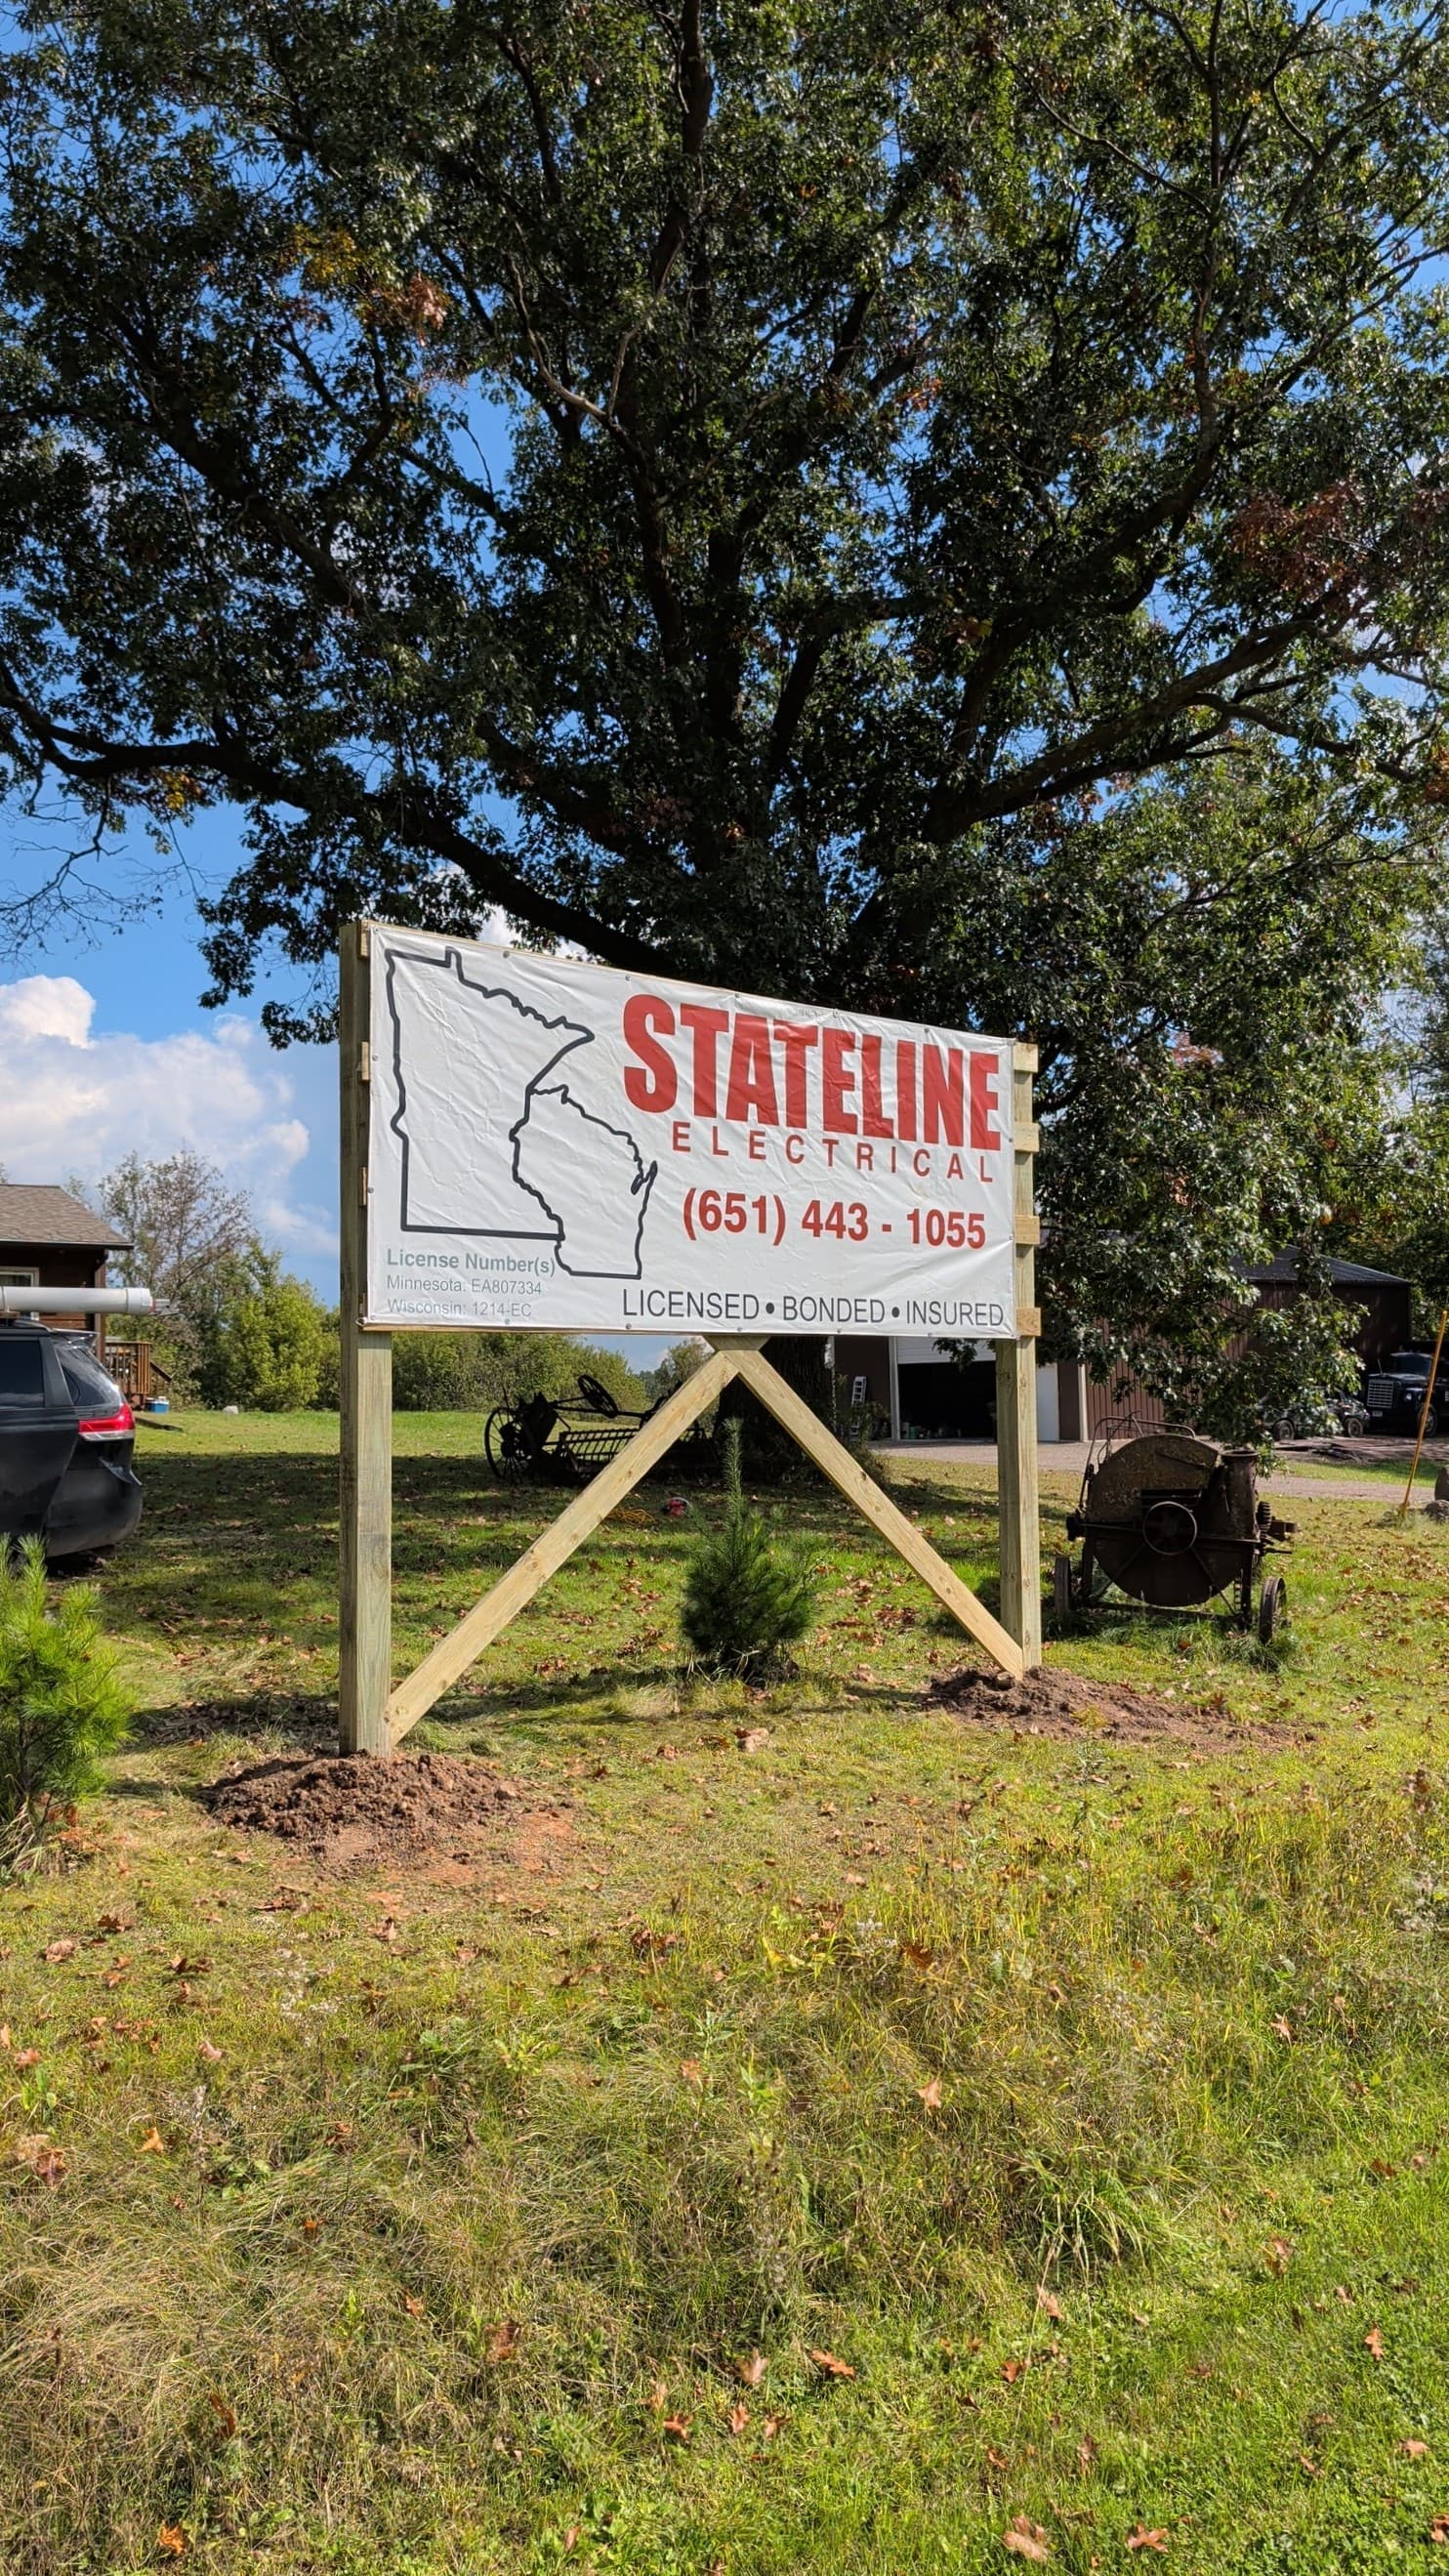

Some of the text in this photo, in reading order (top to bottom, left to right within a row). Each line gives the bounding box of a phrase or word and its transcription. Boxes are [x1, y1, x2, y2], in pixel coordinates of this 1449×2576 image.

[623, 994, 1001, 1151] STATELINE
[673, 1121, 993, 1183] ELECTRICAL
[683, 1187, 787, 1246] (651)
[801, 1199, 869, 1241] 443
[906, 1208, 986, 1250] 1055
[387, 1249, 556, 1277] License Number(s)
[472, 1278, 542, 1295] EA807334
[388, 1299, 532, 1317] Wisconsin: 1214-EC
[622, 1289, 1004, 1327] LICENSED BONDED INSURED
